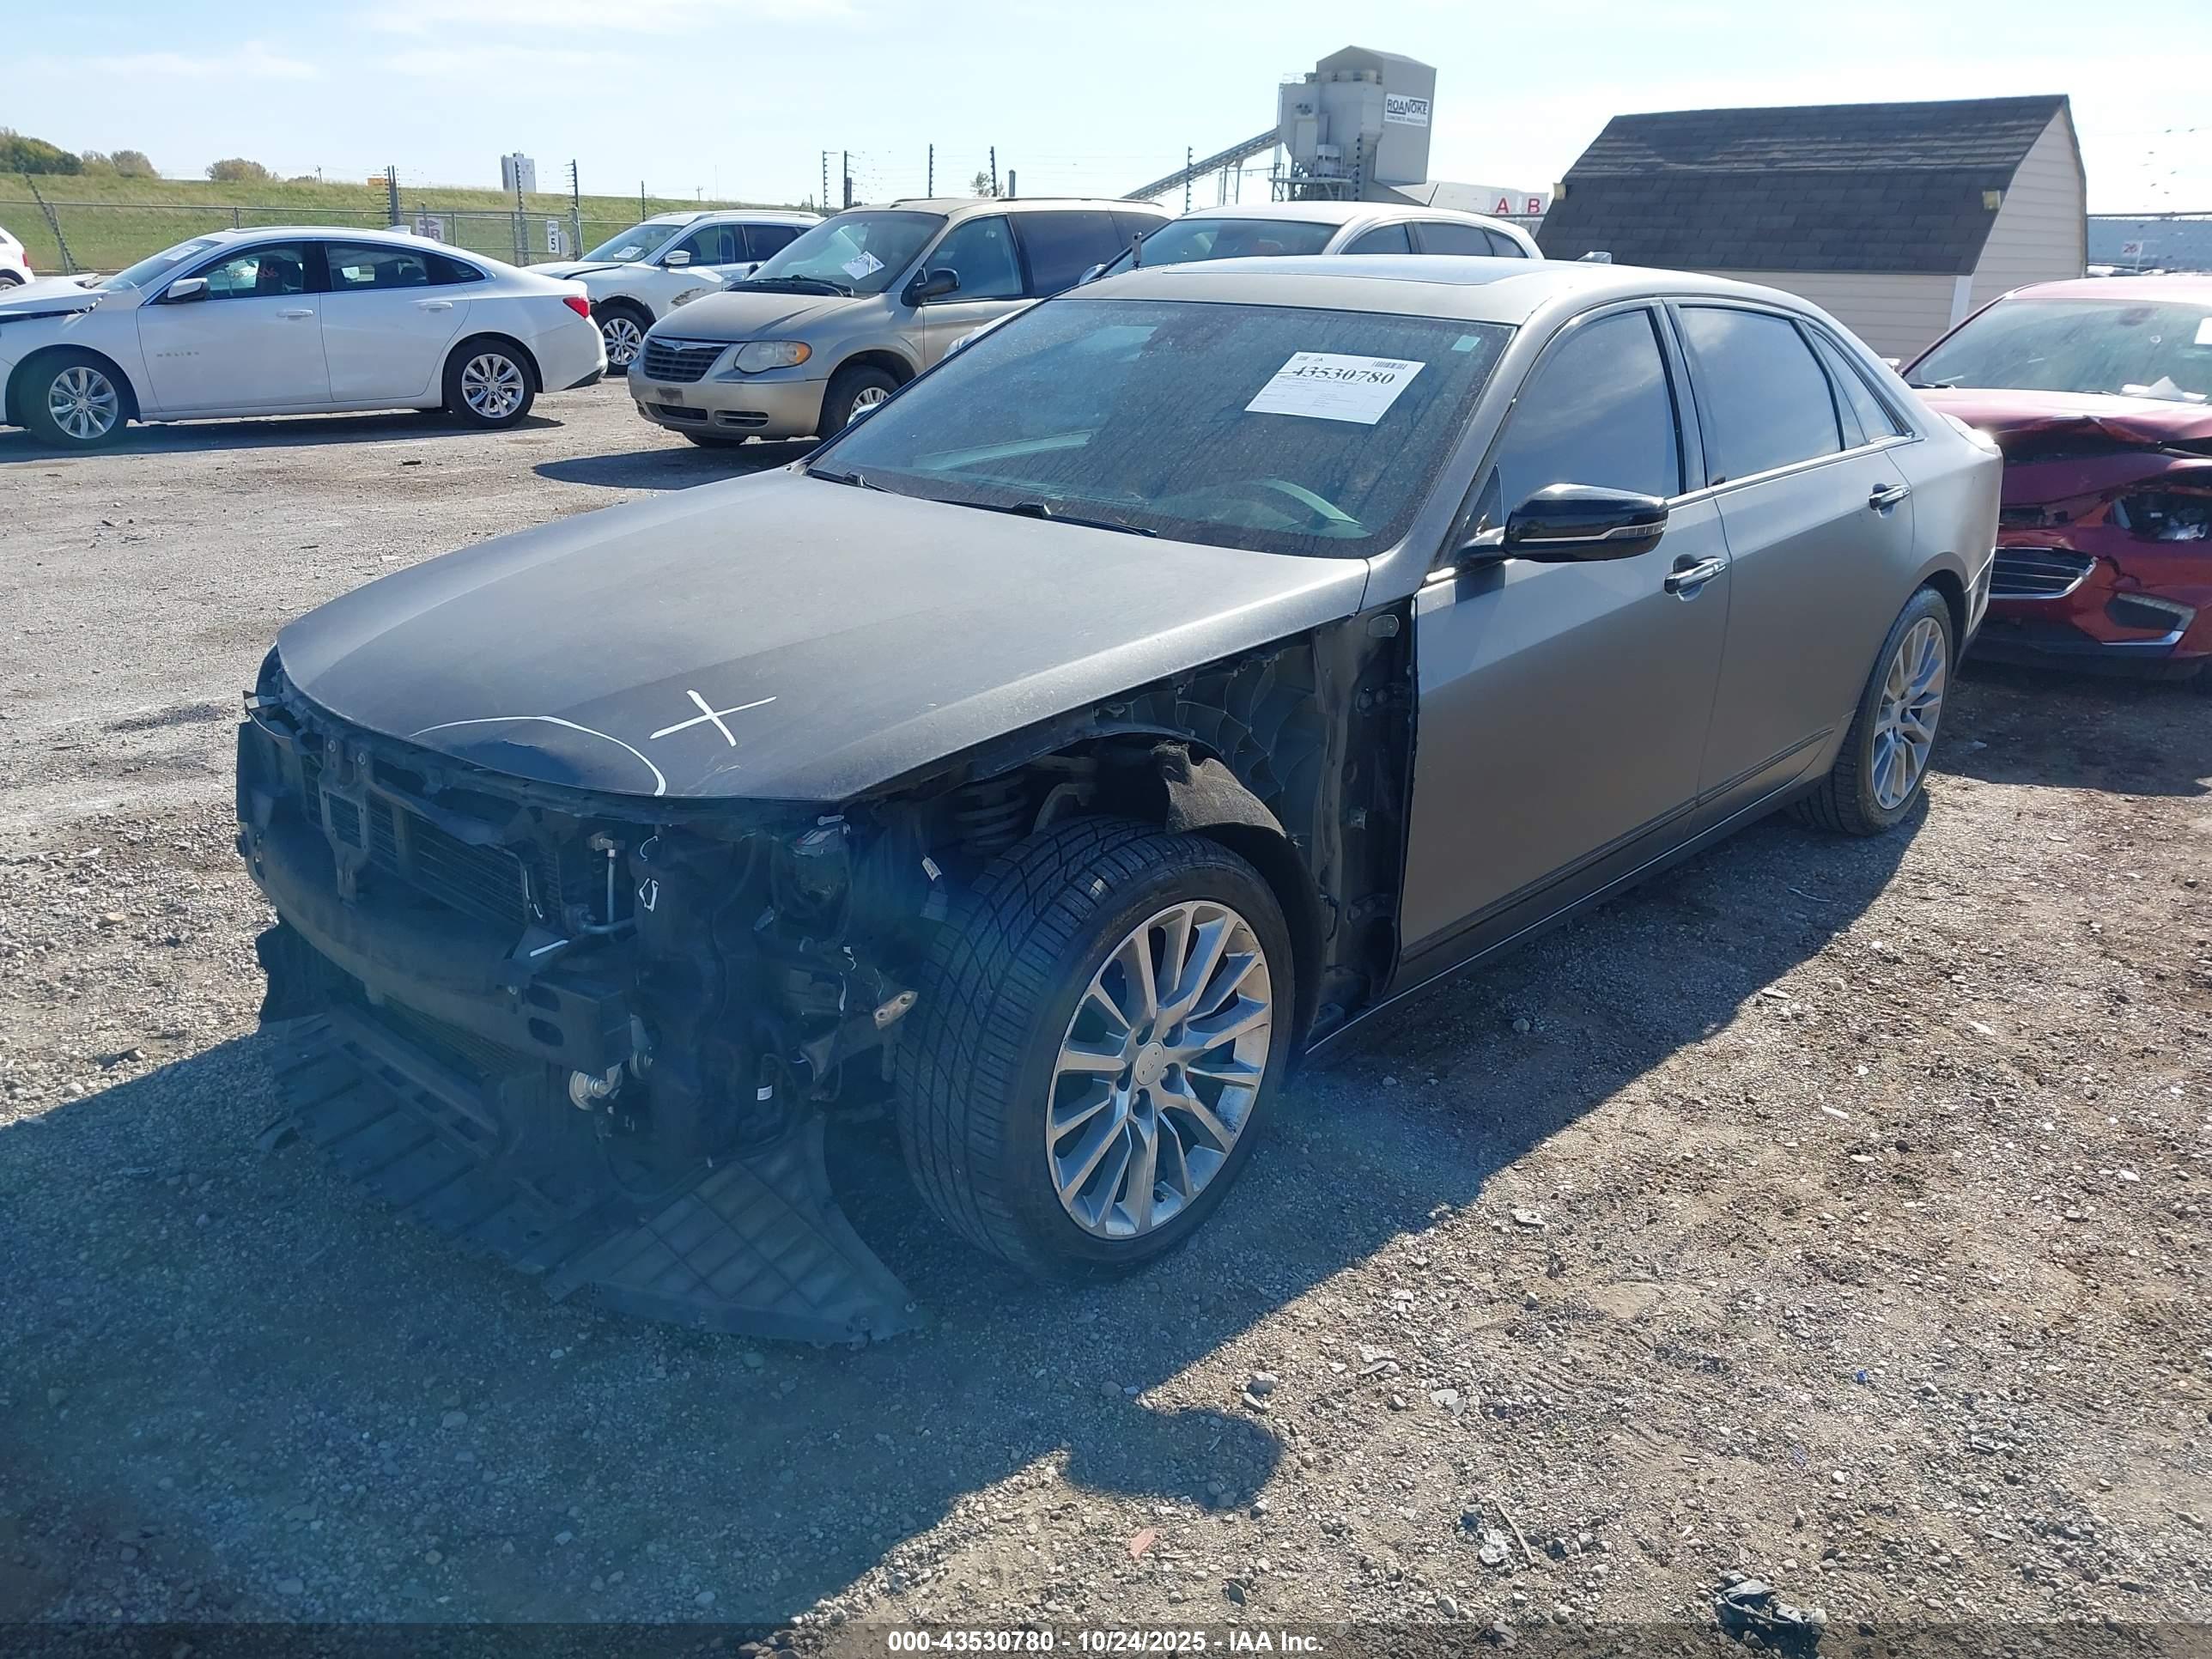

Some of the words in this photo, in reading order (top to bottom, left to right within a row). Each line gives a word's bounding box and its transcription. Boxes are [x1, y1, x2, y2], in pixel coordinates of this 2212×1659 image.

[1387, 99, 1427, 115] ROANOKE
[1495, 198, 1510, 214] A
[1528, 198, 1540, 214] B
[550, 238, 556, 251] 5
[1292, 365, 1395, 385] 43530780
